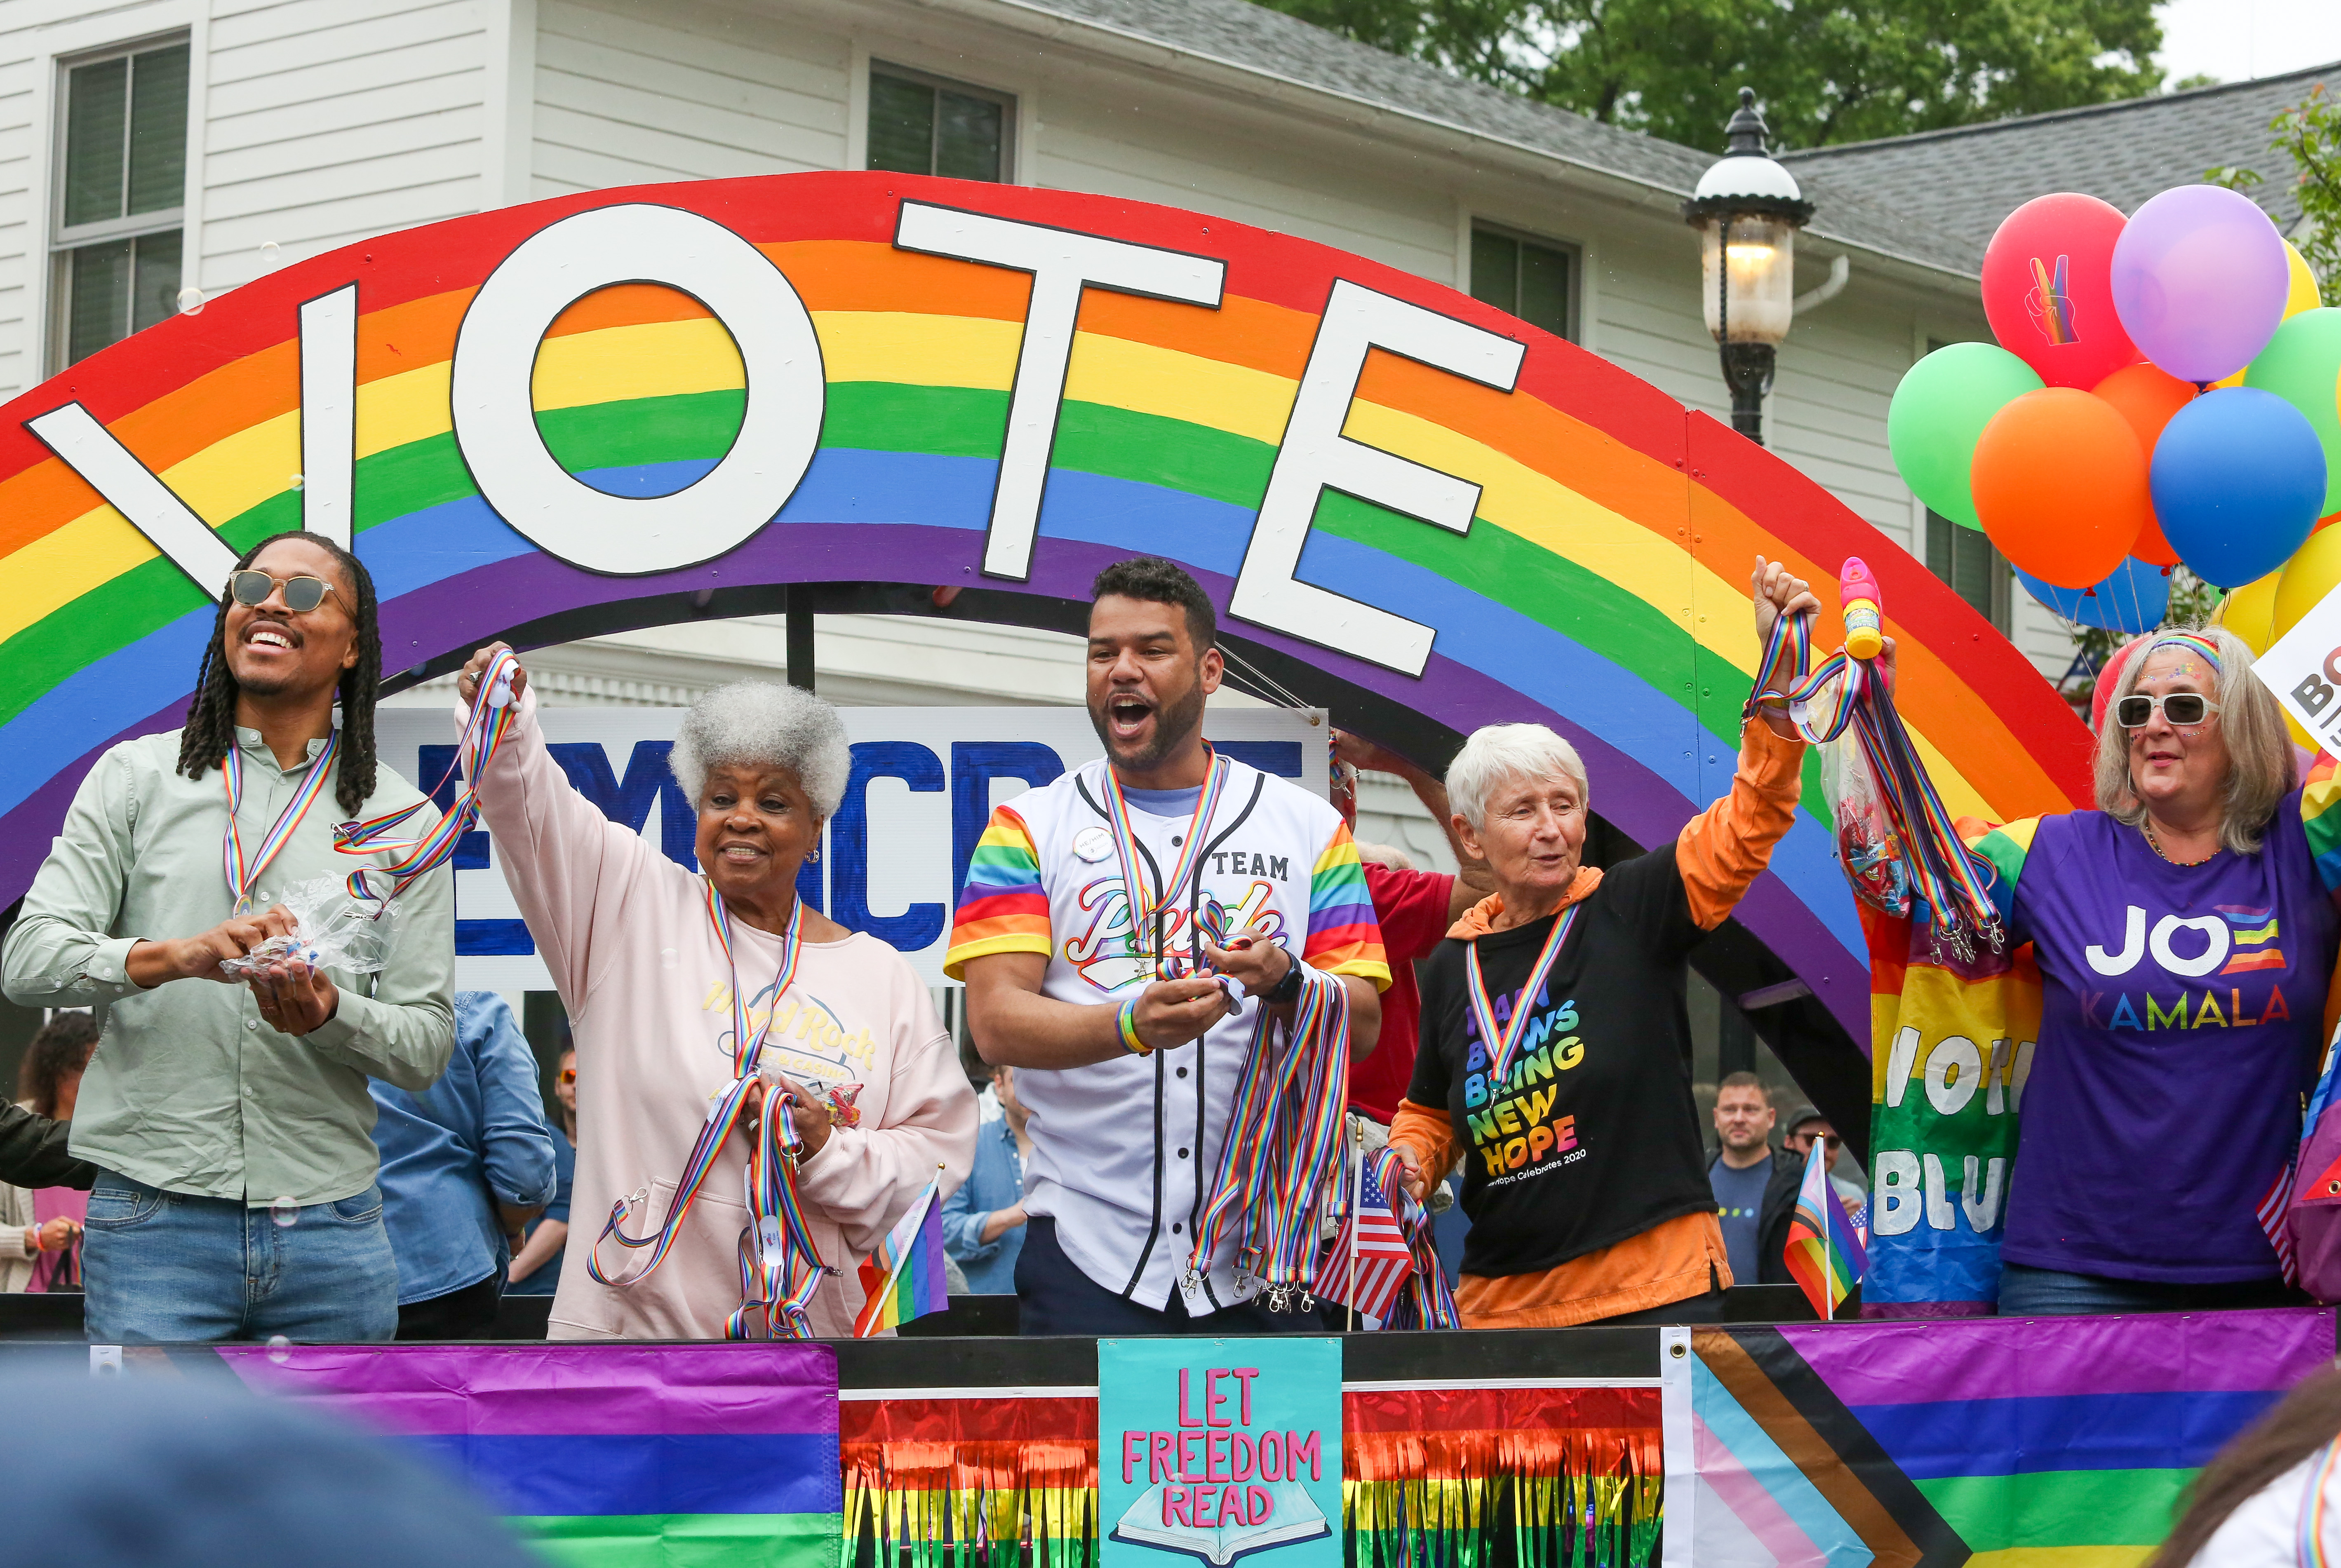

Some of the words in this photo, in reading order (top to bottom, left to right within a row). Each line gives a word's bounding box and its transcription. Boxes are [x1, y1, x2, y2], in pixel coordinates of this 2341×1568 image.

[23, 198, 1528, 679] VOTE
[1079, 833, 1105, 848] HE/HIM
[1212, 852, 1289, 882] TEAM
[2085, 904, 2287, 977] JOE
[1466, 1000, 1579, 1072] BWS
[2080, 984, 2290, 1031] KAMALA
[795, 1007, 876, 1071] Rock
[1467, 1083, 1558, 1146] NEW
[1480, 1115, 1578, 1177] HOPE
[1517, 1160, 1562, 1181] Celebrates
[1563, 1149, 1587, 1164] 2020
[1873, 1148, 2013, 1236] BLU
[1179, 1367, 1259, 1427] LET
[1122, 1430, 1321, 1484] FREEDOM
[1161, 1485, 1274, 1528] READ
